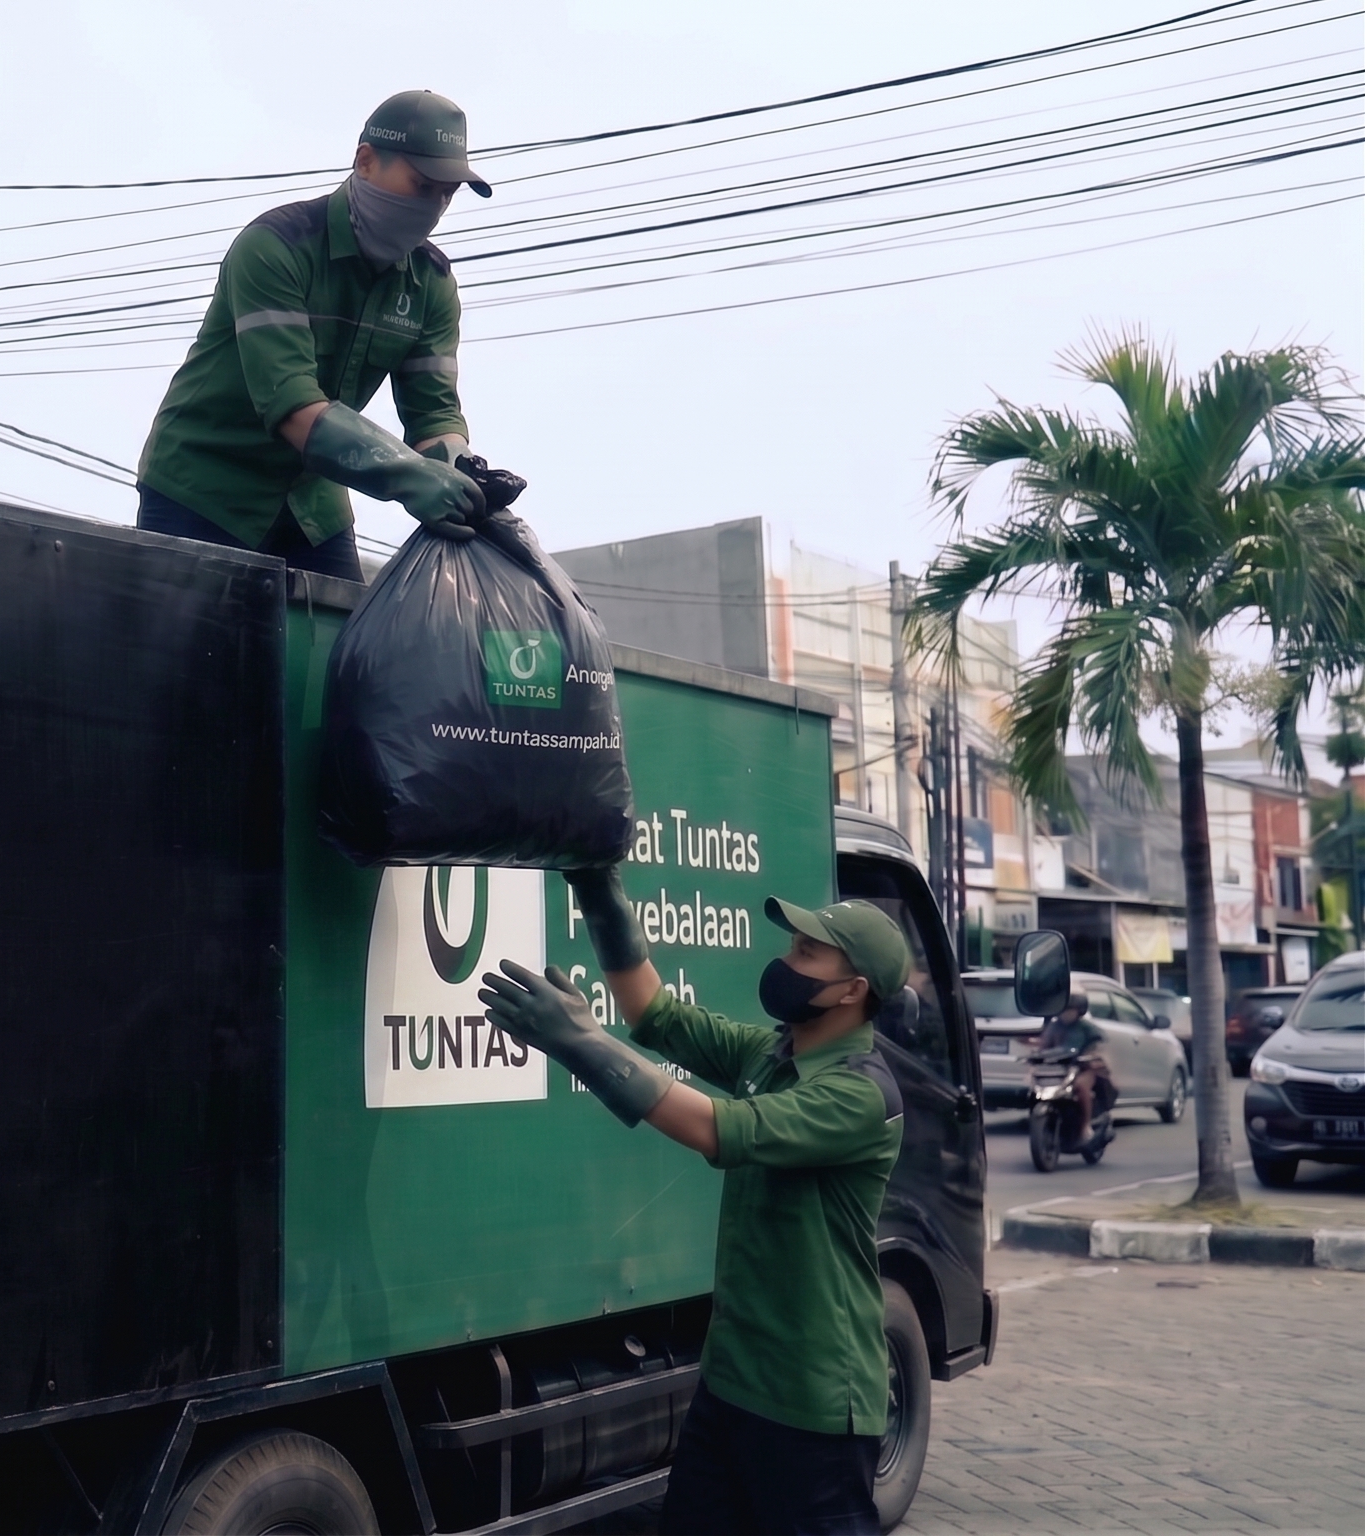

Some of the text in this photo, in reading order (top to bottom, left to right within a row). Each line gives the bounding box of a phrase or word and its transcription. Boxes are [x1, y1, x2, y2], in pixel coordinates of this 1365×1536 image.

[493, 683, 556, 699] TUNTAS
[431, 722, 620, 754] www.tuntassampah.id
[627, 808, 760, 873] at Tuntas
[568, 882, 750, 949] Pebalaan
[569, 964, 695, 1026] Sah
[383, 1015, 528, 1070] TUNTAS
